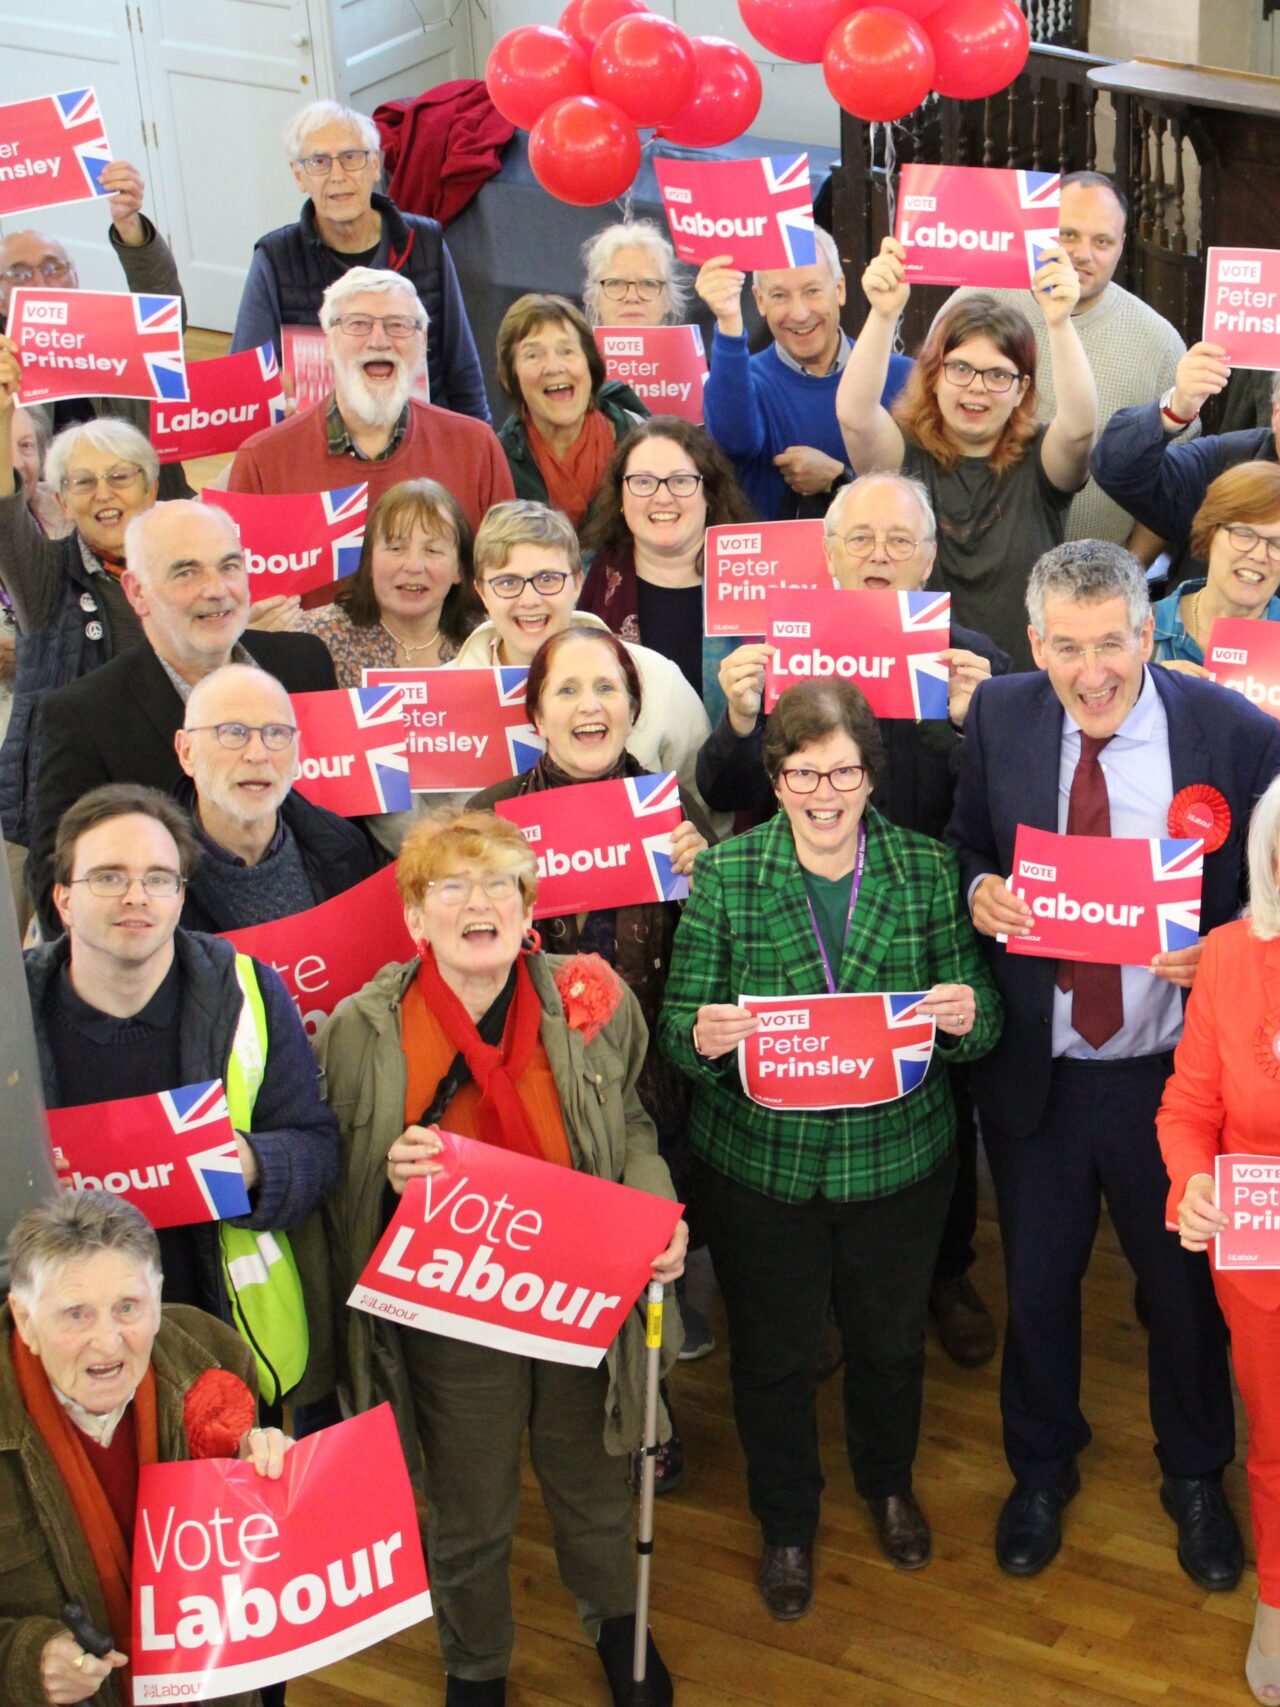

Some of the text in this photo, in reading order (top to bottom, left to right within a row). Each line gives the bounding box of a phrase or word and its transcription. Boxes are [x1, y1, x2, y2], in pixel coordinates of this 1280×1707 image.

[0, 156, 61, 181] nsley
[906, 197, 934, 209] VOTE
[669, 207, 768, 238] Labour
[901, 220, 1014, 251] Labour
[1221, 265, 1257, 278] VOTE
[1216, 286, 1277, 309] Peter
[26, 306, 65, 320] VOTE
[21, 326, 86, 349] Peter
[606, 341, 641, 352] VOTE
[21, 351, 128, 376] Prinsley
[606, 359, 660, 376] Peter
[628, 379, 692, 401] nsley
[156, 403, 260, 434] Labour
[720, 538, 759, 551] VOTE
[243, 547, 323, 575] bour
[718, 558, 779, 577] Peter
[717, 579, 818, 602] Prin
[775, 624, 809, 635] VOTE
[772, 648, 896, 679] Labour
[1215, 650, 1245, 662] VOTE
[402, 708, 447, 727] eter
[404, 731, 490, 759] insley
[294, 754, 356, 780] our
[1022, 864, 1054, 879] VOTE
[760, 1013, 806, 1027] VOTE
[758, 1034, 830, 1056] Peter
[758, 1055, 874, 1079] Prinsley
[67, 1162, 175, 1195] bour
[424, 1174, 543, 1251] Vote
[377, 1225, 622, 1330] Labour
[372, 1298, 419, 1321] Labour
[142, 1505, 281, 1573] Vote
[140, 1531, 403, 1652] Labour
